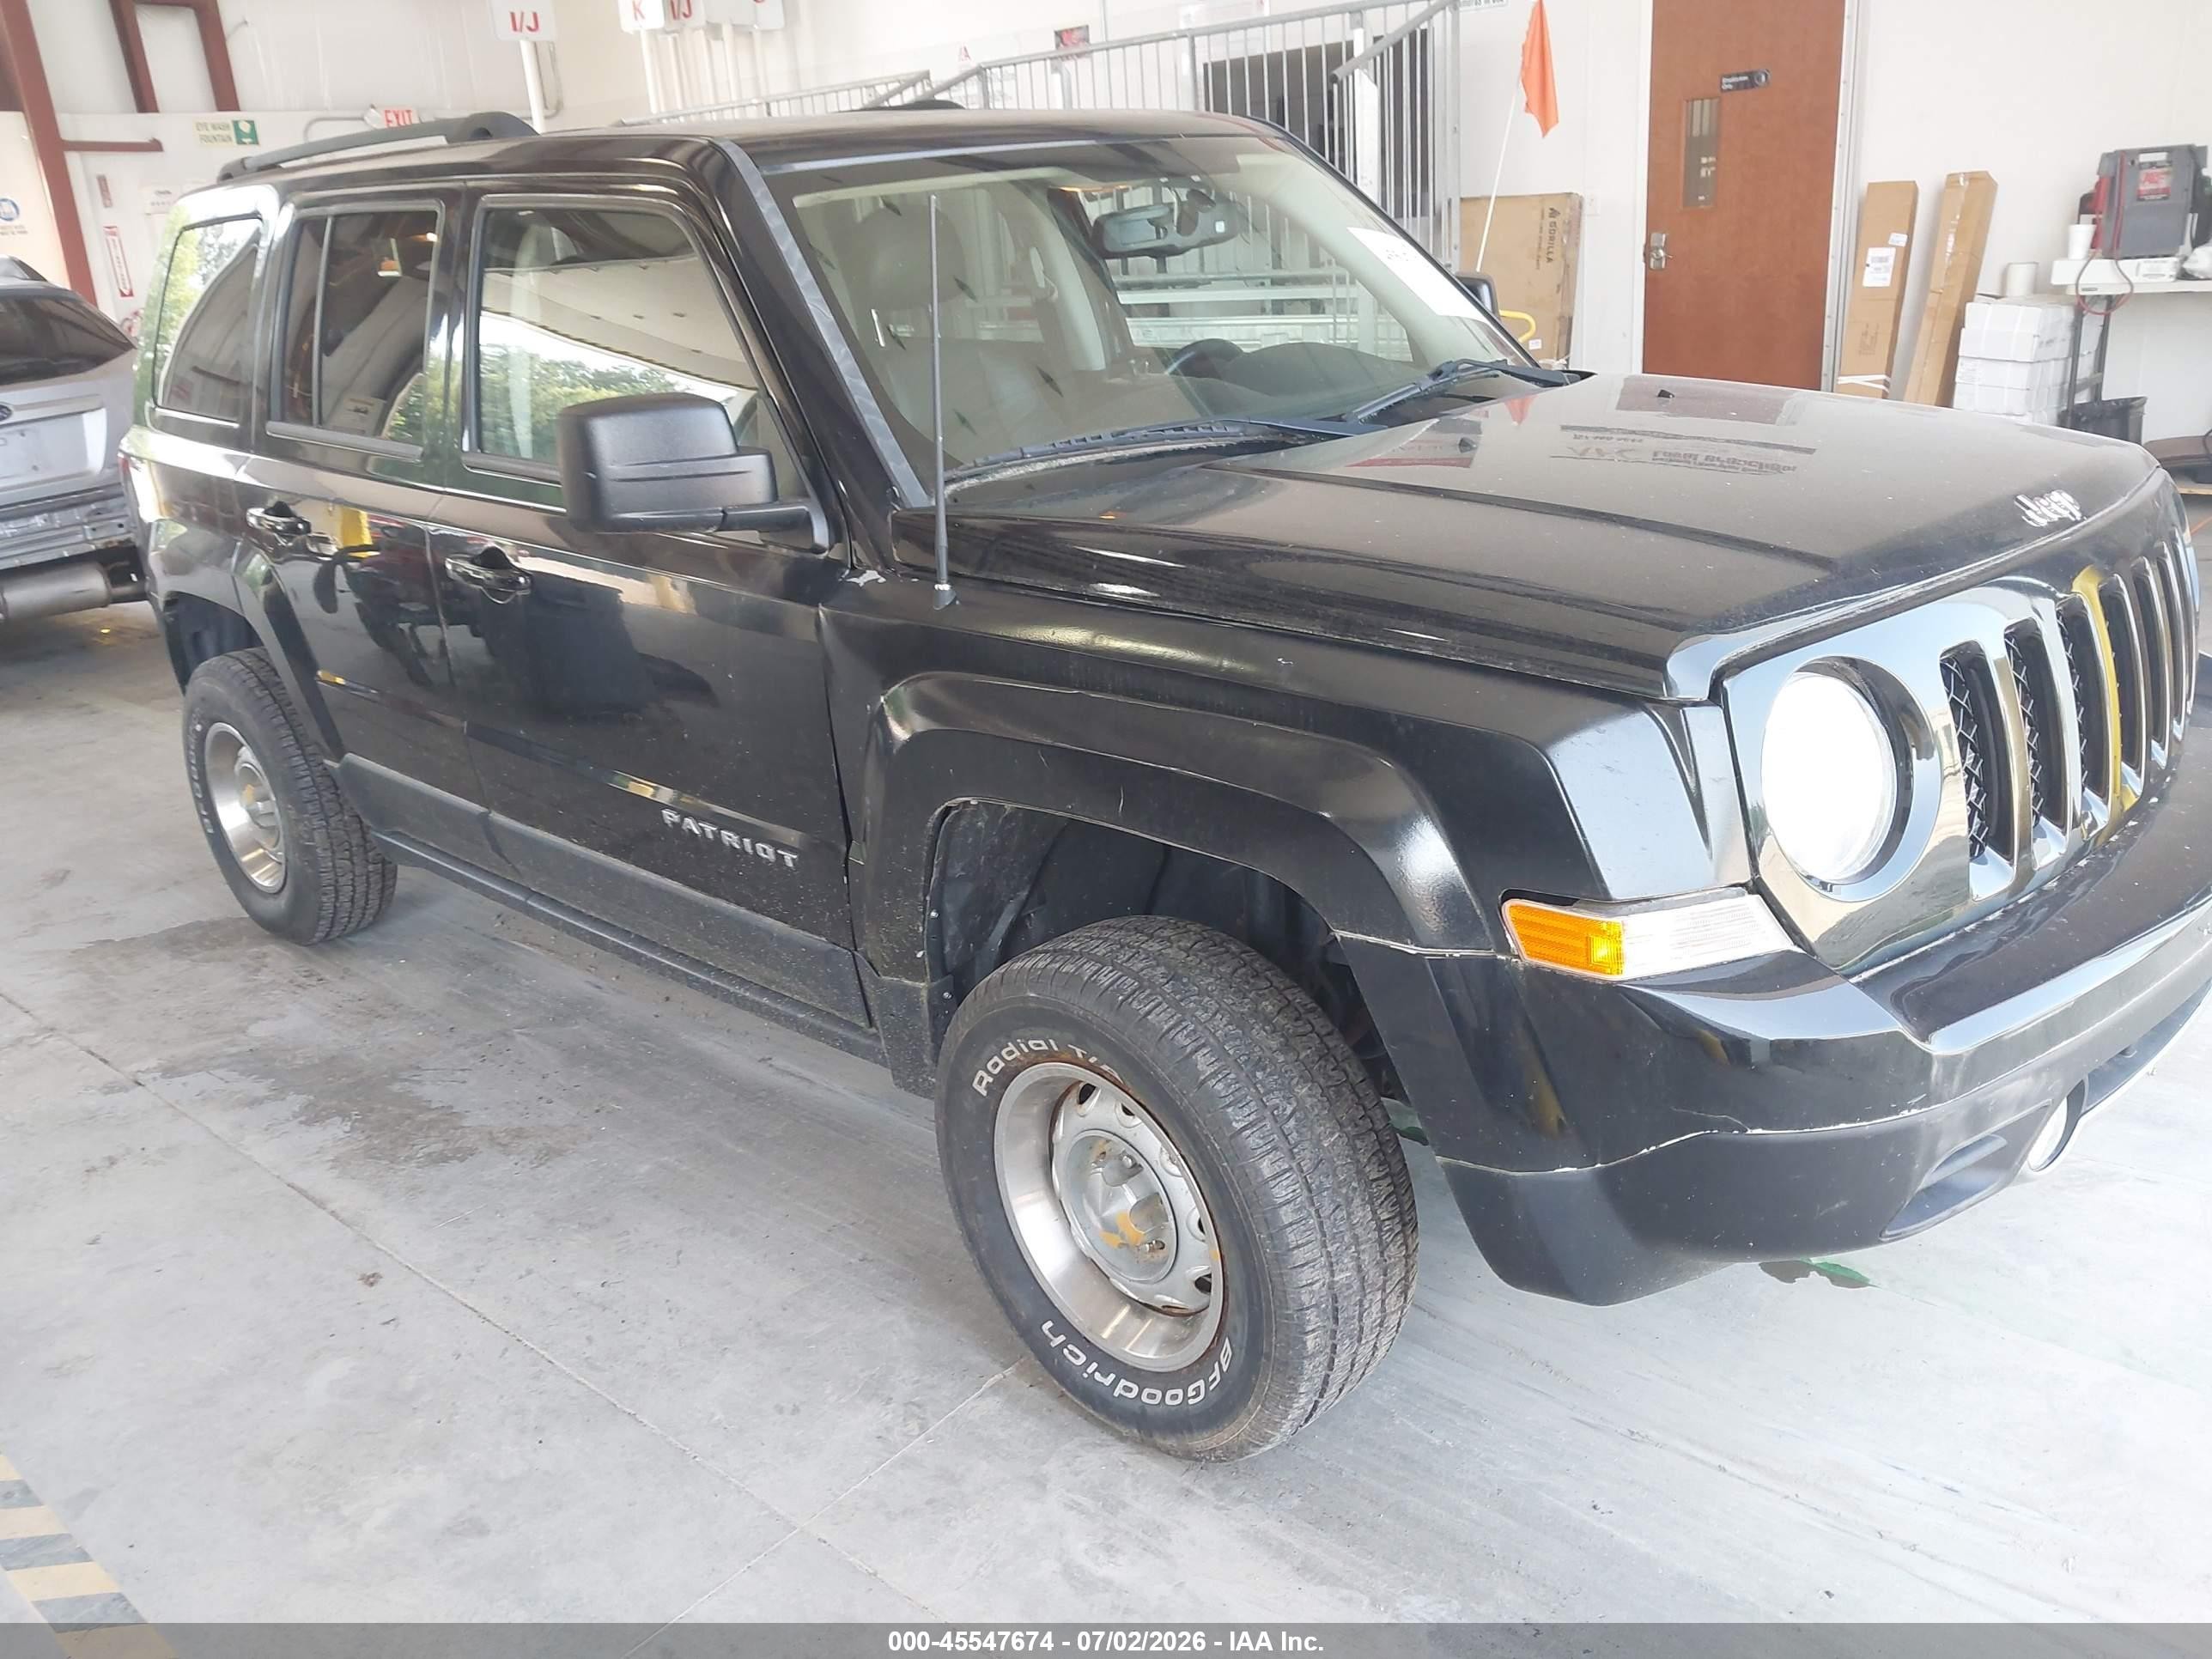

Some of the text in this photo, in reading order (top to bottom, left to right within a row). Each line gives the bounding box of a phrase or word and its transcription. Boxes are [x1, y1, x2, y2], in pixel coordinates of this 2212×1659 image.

[510, 12, 539, 33] I/J
[384, 109, 412, 128] EXIT
[2014, 489, 2082, 527] Jeep
[661, 808, 798, 867] PATRIOT
[972, 1038, 1059, 1097] Radial
[1041, 1320, 1233, 1406] BFGoodrich
